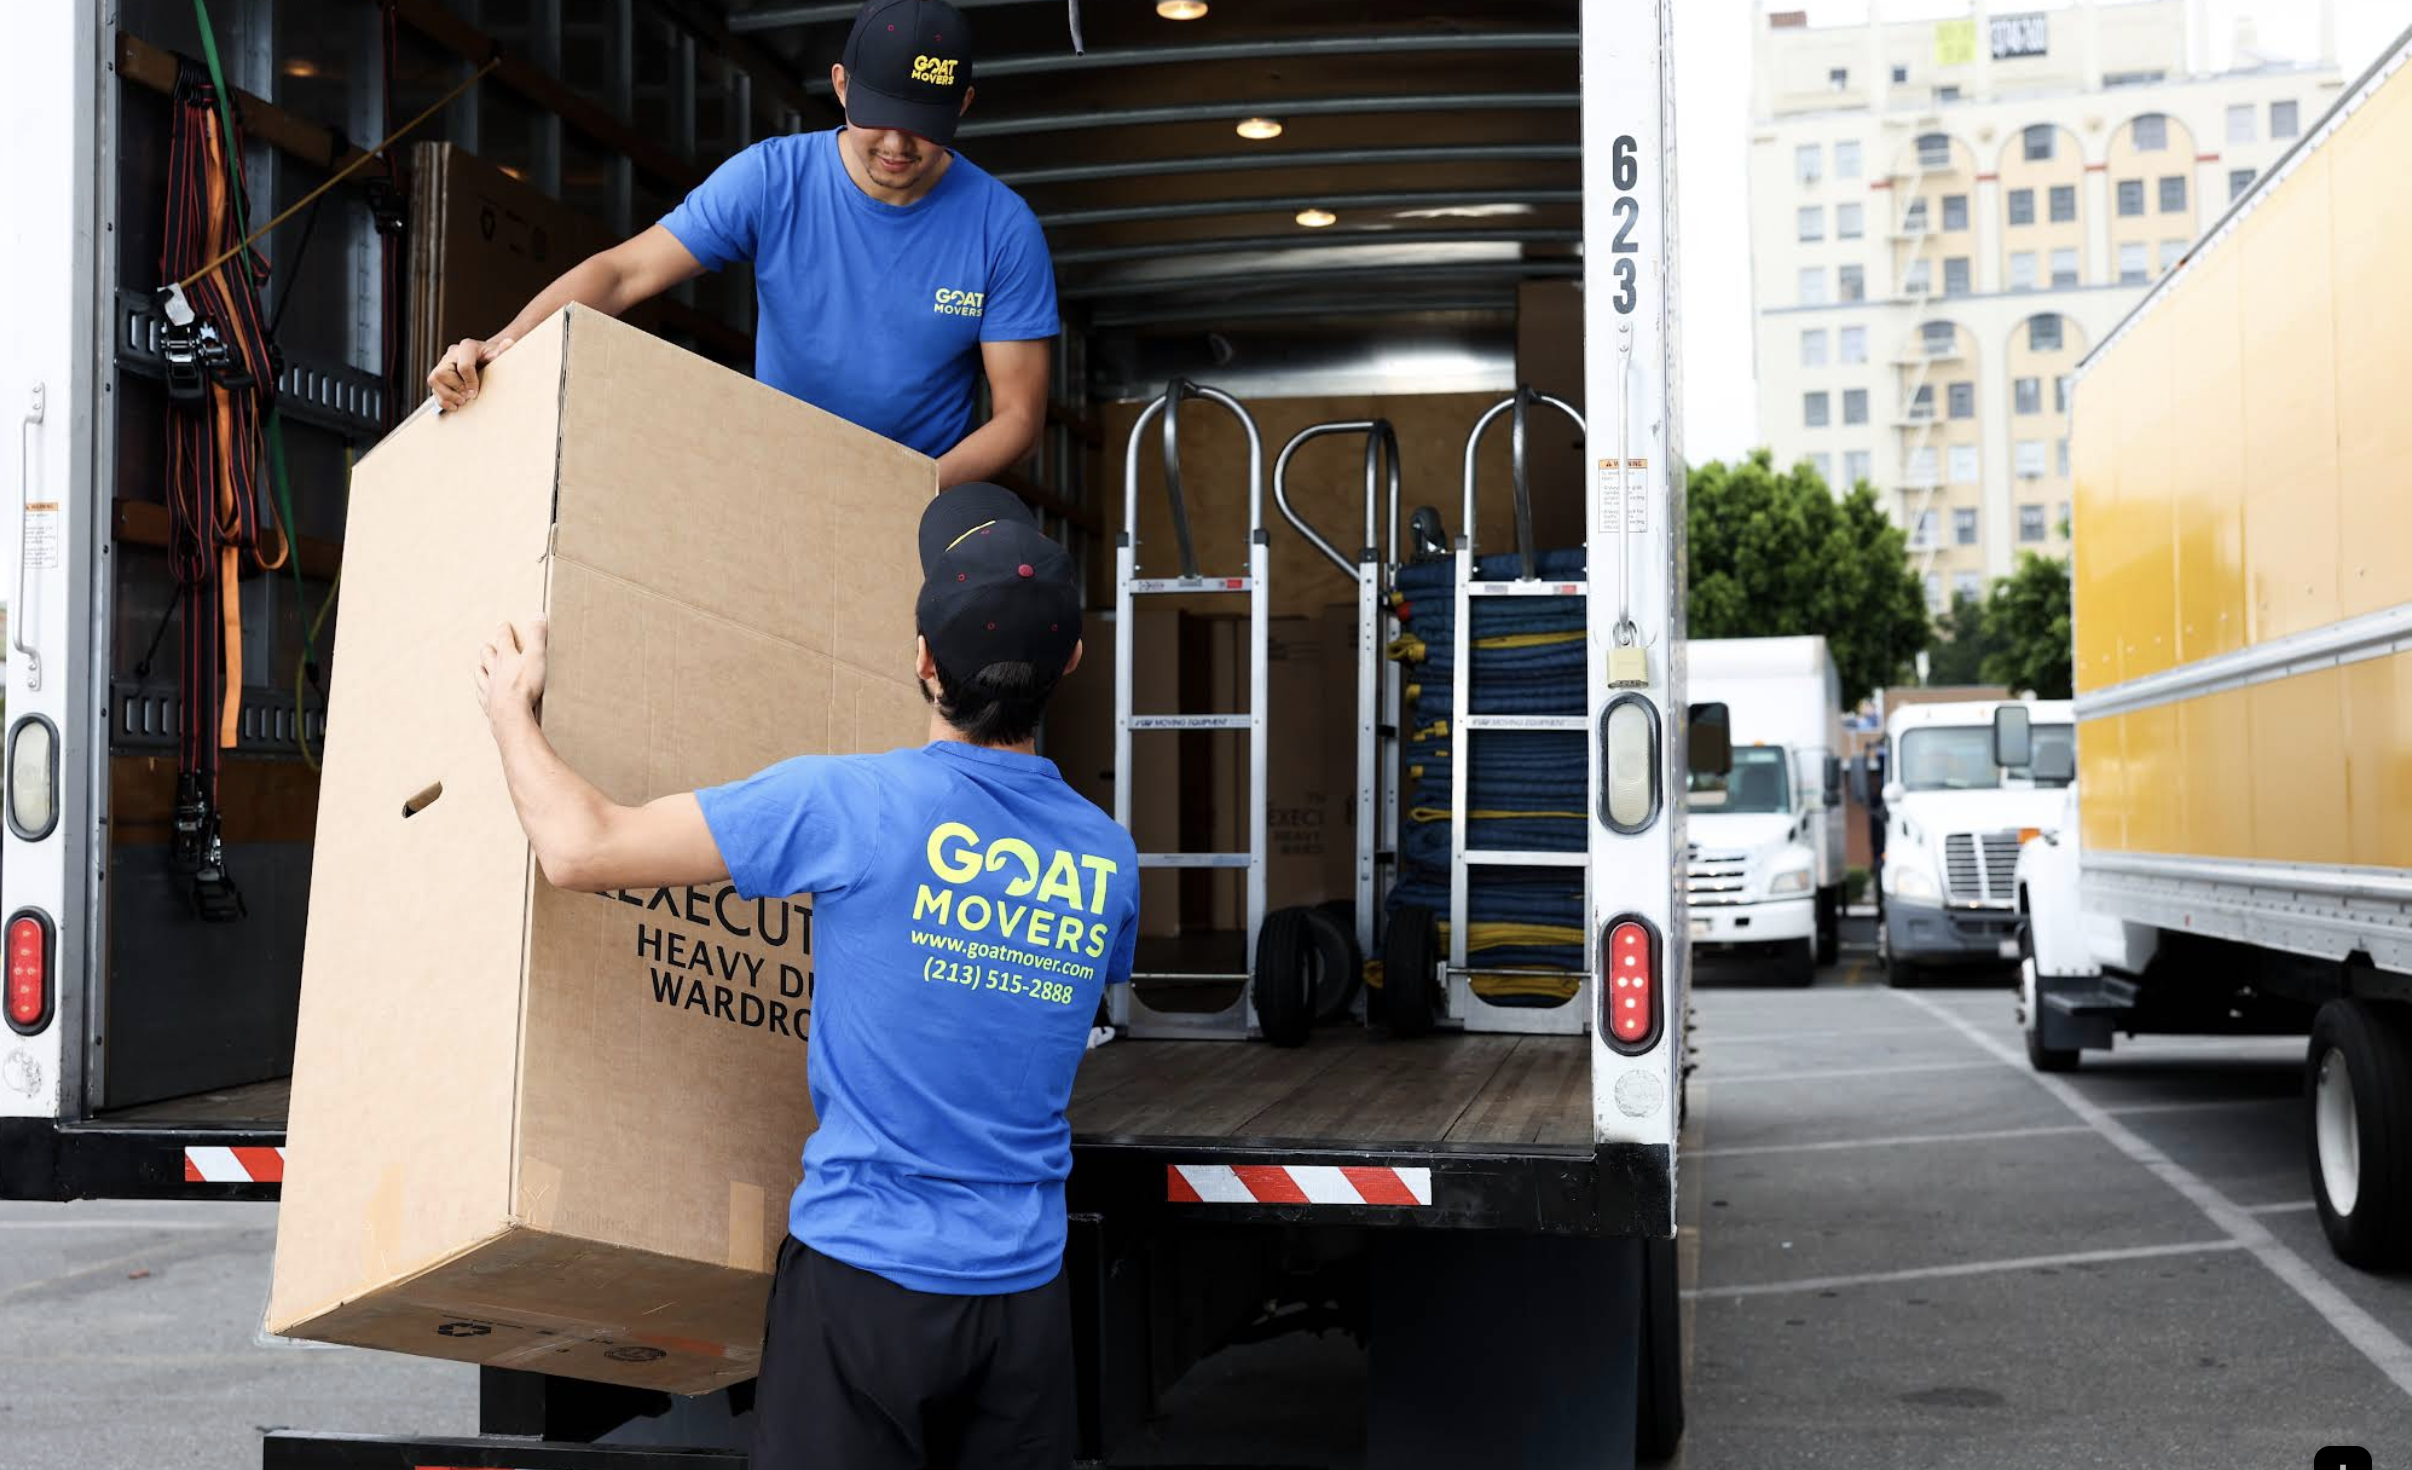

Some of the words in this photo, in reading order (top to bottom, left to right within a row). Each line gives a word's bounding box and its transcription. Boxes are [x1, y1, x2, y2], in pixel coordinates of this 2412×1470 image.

[911, 69, 955, 85] MOVERS
[914, 55, 959, 76] GOAT
[1611, 134, 1639, 315] 623
[934, 303, 983, 317] MOVERS
[935, 288, 985, 308] GOAT
[926, 822, 1117, 915] GOAT
[912, 884, 1109, 957] MOVERS
[637, 923, 765, 988] HEAVY
[911, 930, 1094, 980] www.goatmover.com
[924, 956, 981, 990] (213)
[985, 969, 1073, 1004] 515-2888
